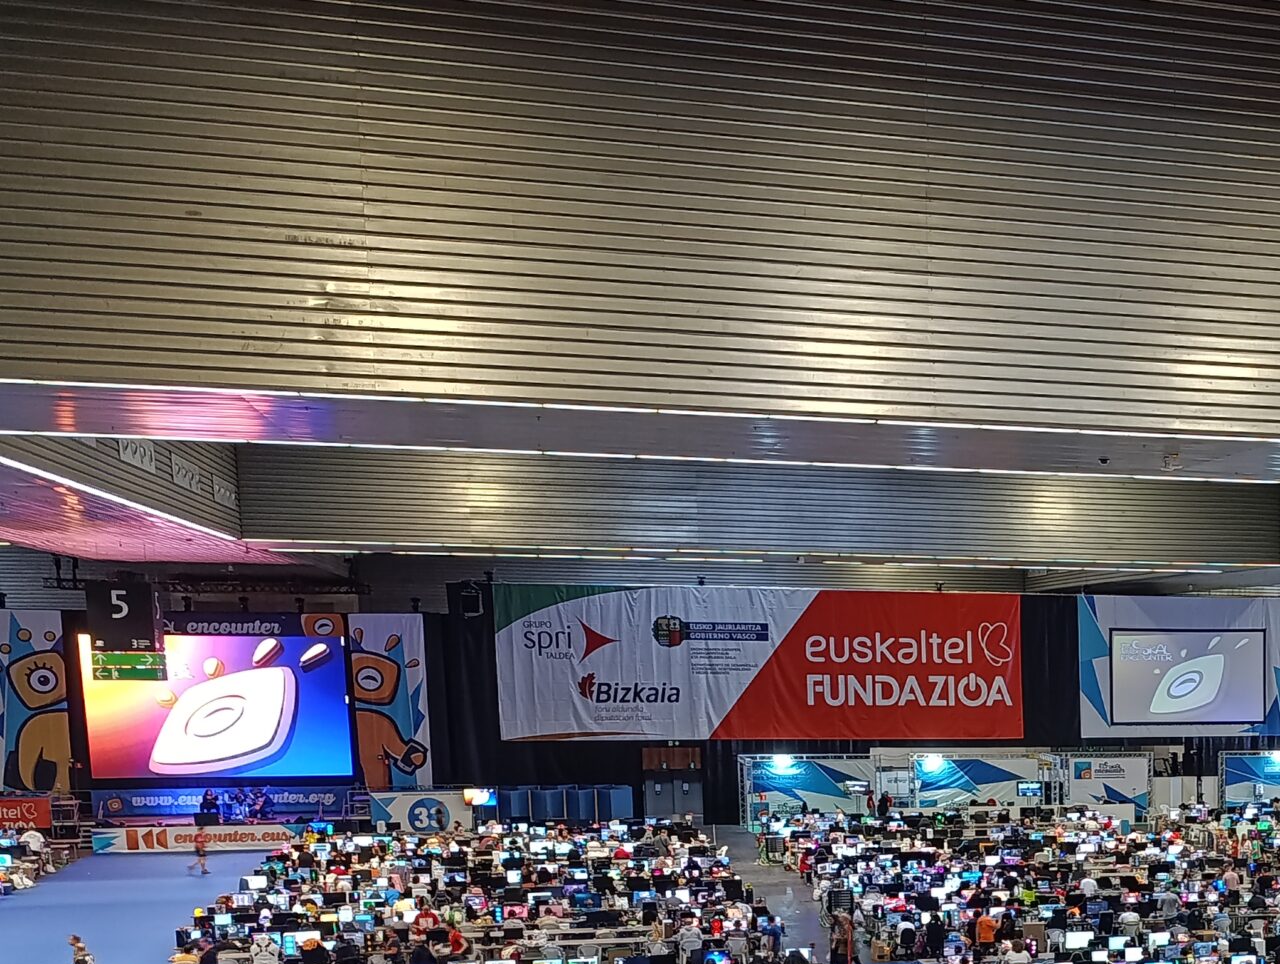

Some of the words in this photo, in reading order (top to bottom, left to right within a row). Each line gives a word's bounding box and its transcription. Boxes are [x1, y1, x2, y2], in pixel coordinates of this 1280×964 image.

[110, 589, 129, 619] 5
[186, 618, 281, 635] encounter
[523, 620, 551, 629] GRUPO
[523, 625, 572, 656] spri
[805, 630, 973, 664] euskaltel
[545, 651, 575, 660] TALDEA
[595, 682, 681, 704] Bizkaia
[806, 673, 1013, 707] FUNDAZIOA
